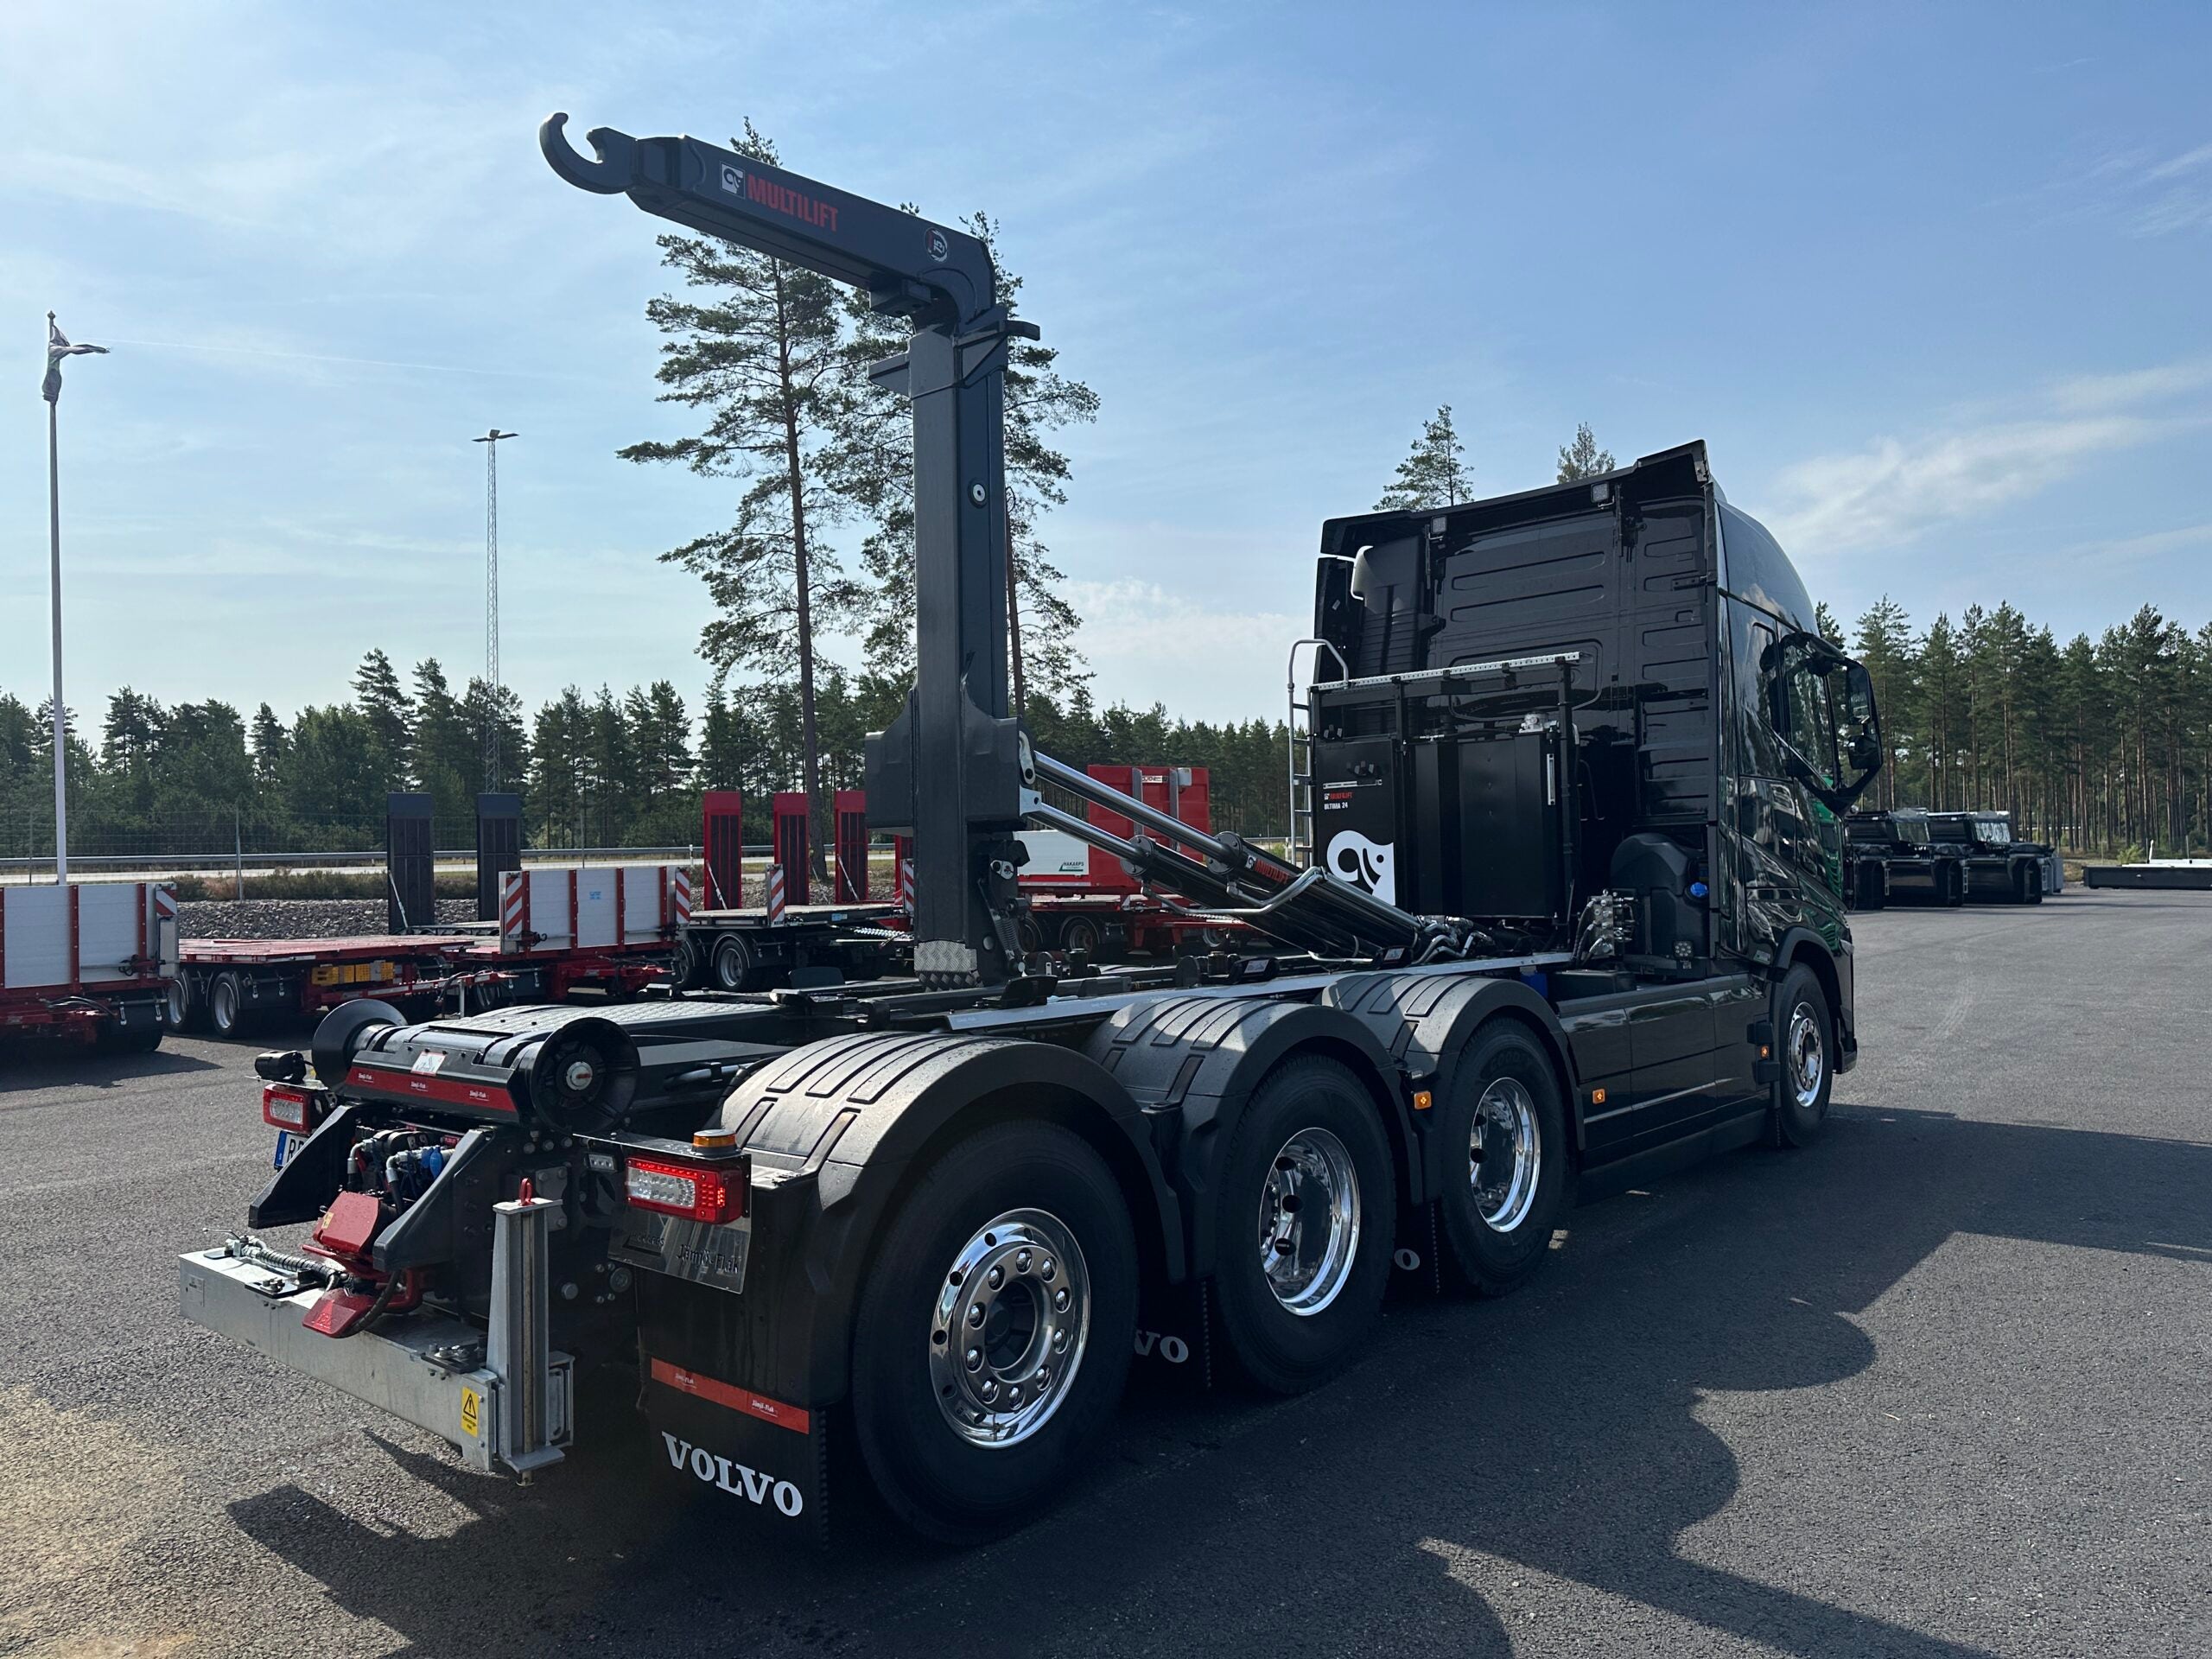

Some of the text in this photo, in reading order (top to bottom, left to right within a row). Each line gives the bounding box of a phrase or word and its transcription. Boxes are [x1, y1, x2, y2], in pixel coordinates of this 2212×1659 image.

[747, 173, 838, 232] MULTILIFT
[1254, 859, 1291, 885] MULTILIFT
[661, 1430, 804, 1518] VOLVO
